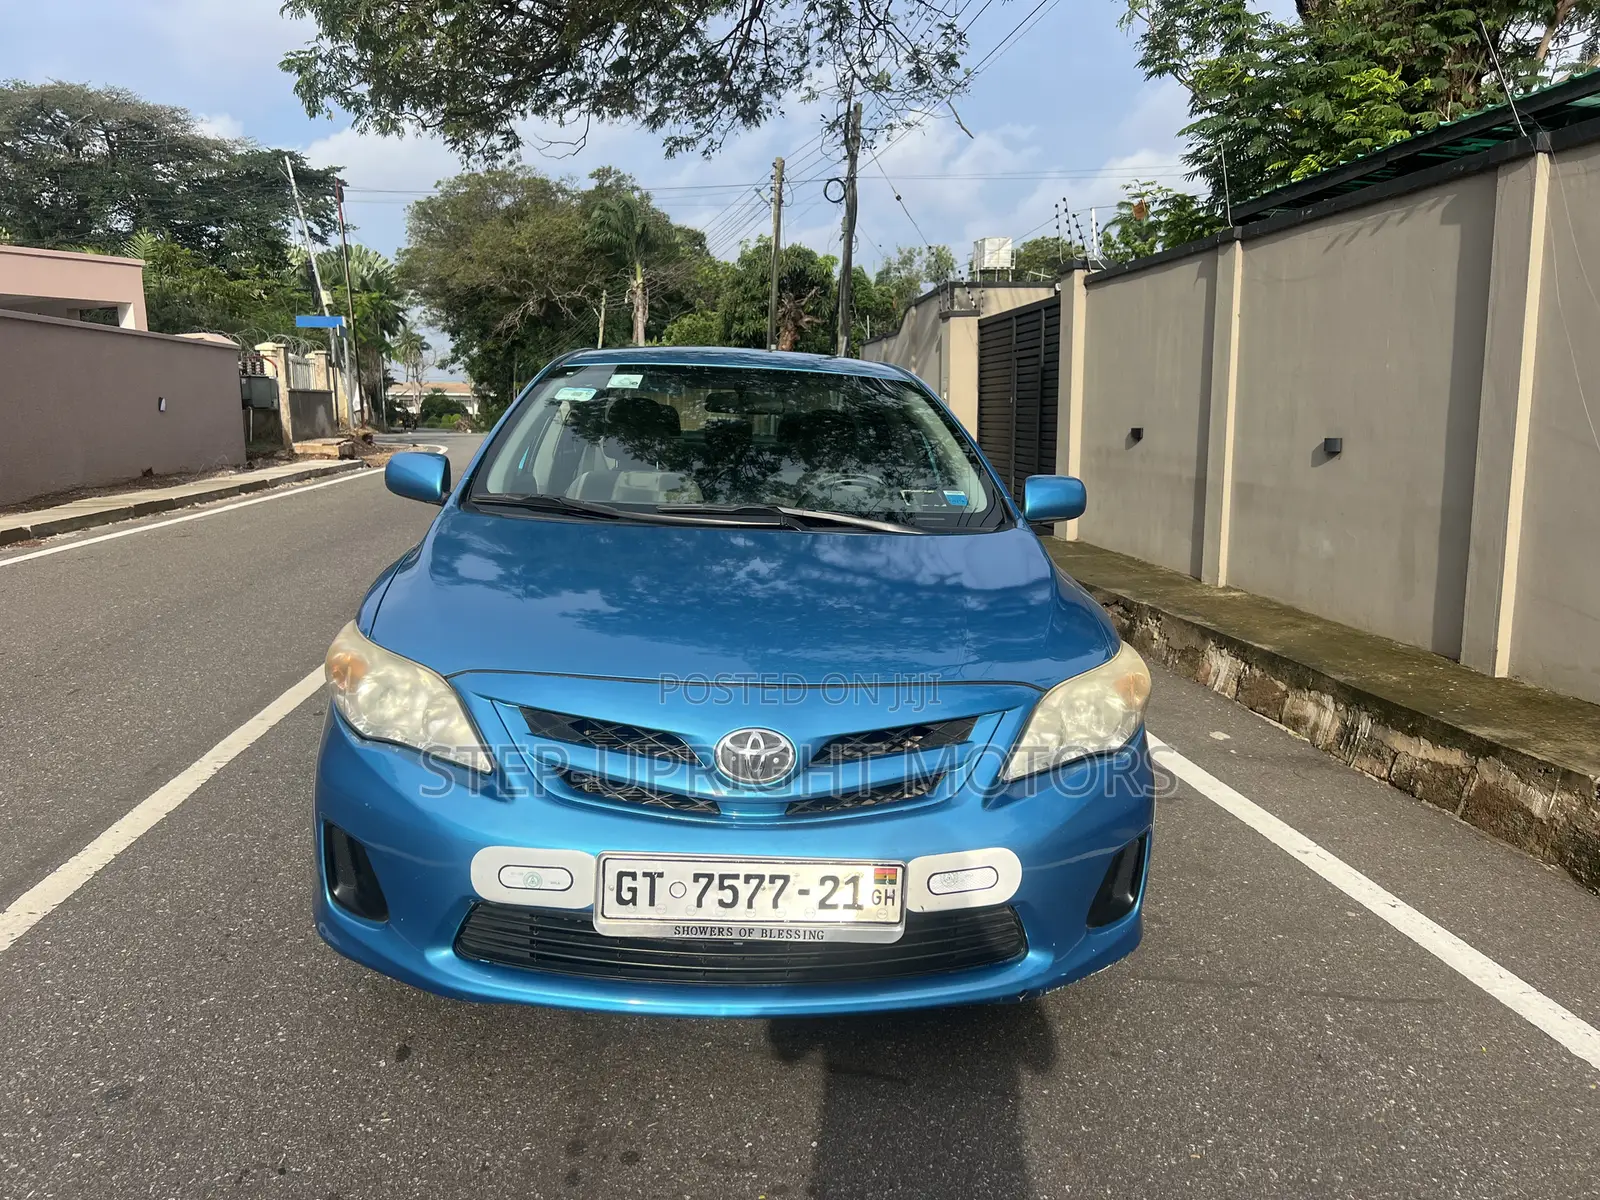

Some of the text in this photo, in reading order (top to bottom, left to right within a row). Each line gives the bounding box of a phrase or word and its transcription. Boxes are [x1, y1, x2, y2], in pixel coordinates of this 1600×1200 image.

[615, 870, 664, 907] GT
[871, 888, 896, 907] GH
[673, 925, 825, 941] SHOWERS OF BLESSING
